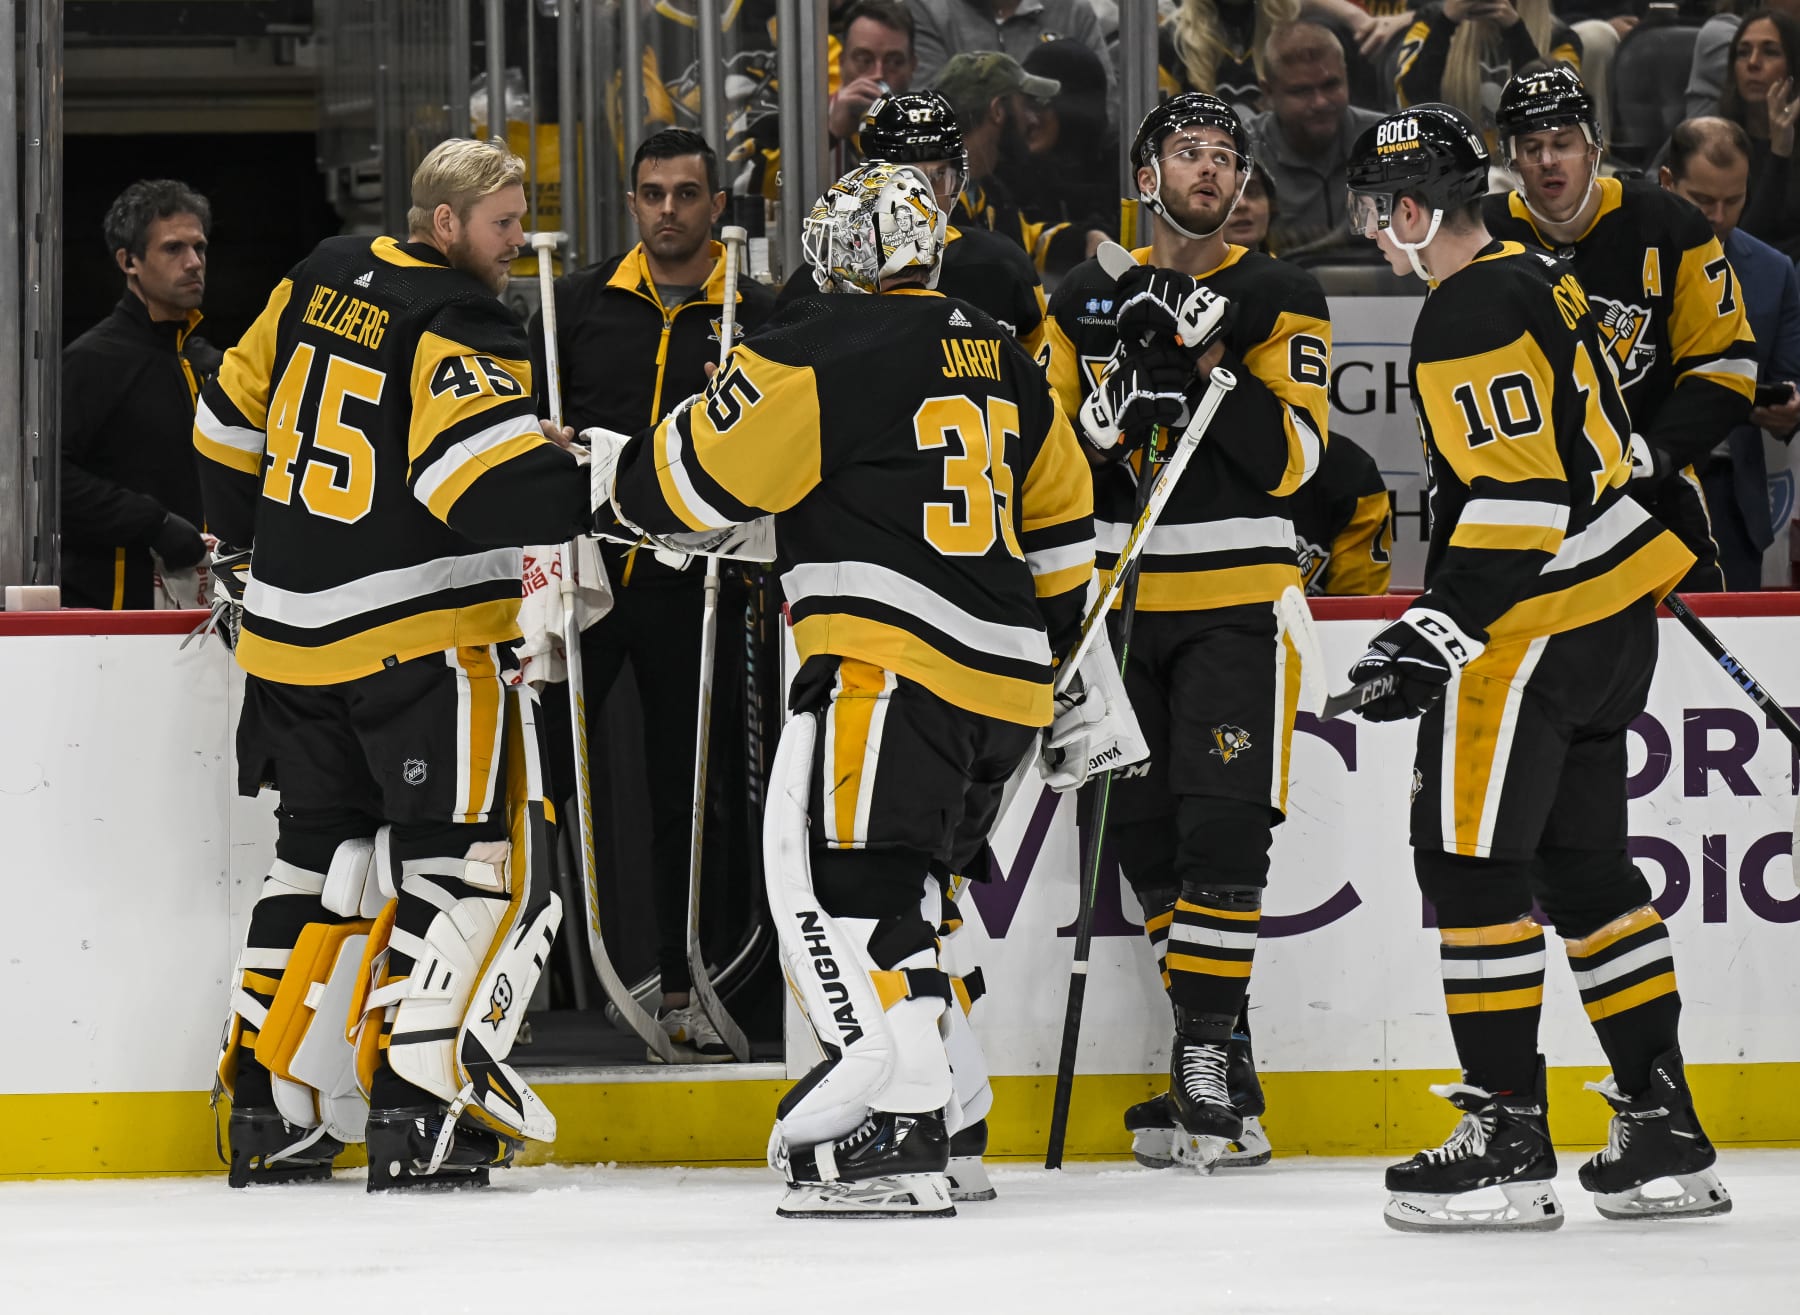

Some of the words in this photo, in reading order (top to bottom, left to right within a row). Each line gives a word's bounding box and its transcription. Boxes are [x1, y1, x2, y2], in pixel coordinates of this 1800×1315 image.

[1526, 80, 1549, 95] 71
[1525, 104, 1558, 115] BAUER
[906, 135, 941, 144] CCM
[1377, 117, 1419, 146] BOLD
[1377, 140, 1419, 155] PENGUIN
[1642, 247, 1662, 299] A
[302, 284, 390, 350] HELLBERG
[429, 354, 523, 400] 45
[941, 338, 1001, 381] JARRY
[1452, 370, 1545, 449] 10
[262, 341, 387, 525] 45
[913, 394, 1025, 562] 35
[1416, 615, 1468, 668] CC
[1360, 674, 1395, 706] CCM
[1087, 746, 1122, 771] VAUG
[796, 911, 864, 1047] VAUGHN
[1656, 1067, 1676, 1089] CCM
[1401, 1201, 1426, 1214] CCM
